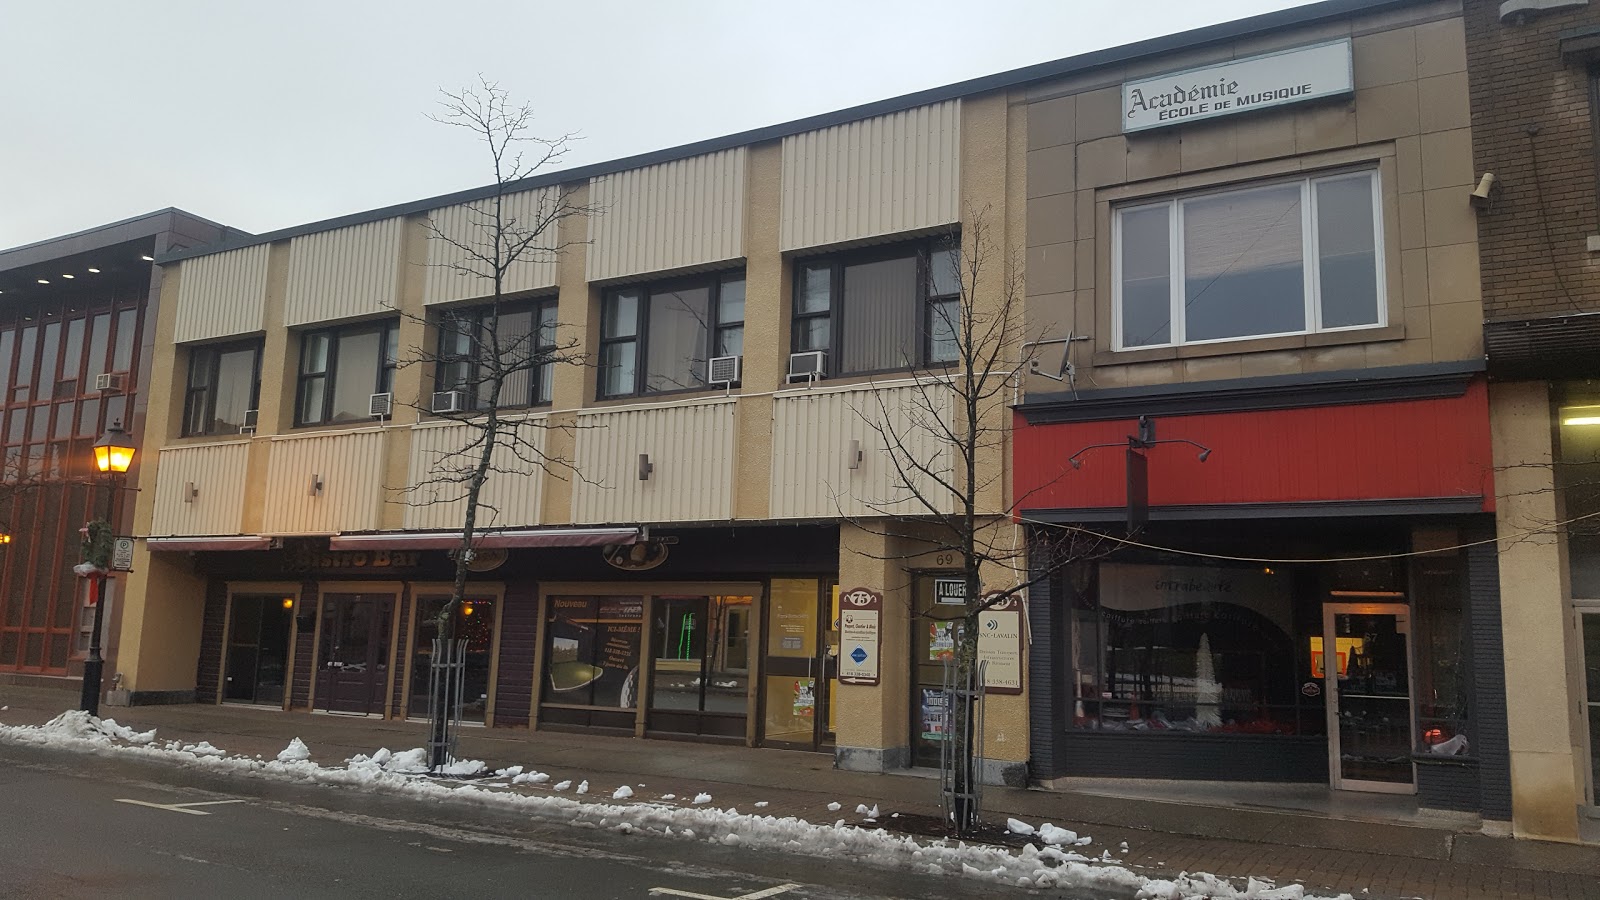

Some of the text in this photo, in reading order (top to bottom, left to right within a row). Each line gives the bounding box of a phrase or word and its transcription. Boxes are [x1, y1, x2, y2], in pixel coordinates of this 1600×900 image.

[1127, 77, 1239, 119] Académie
[1158, 83, 1312, 121] ÉCOLE DE MUSIQUE
[936, 554, 953, 566] 69
[945, 583, 967, 597] LOUER
[853, 593, 868, 604] 75
